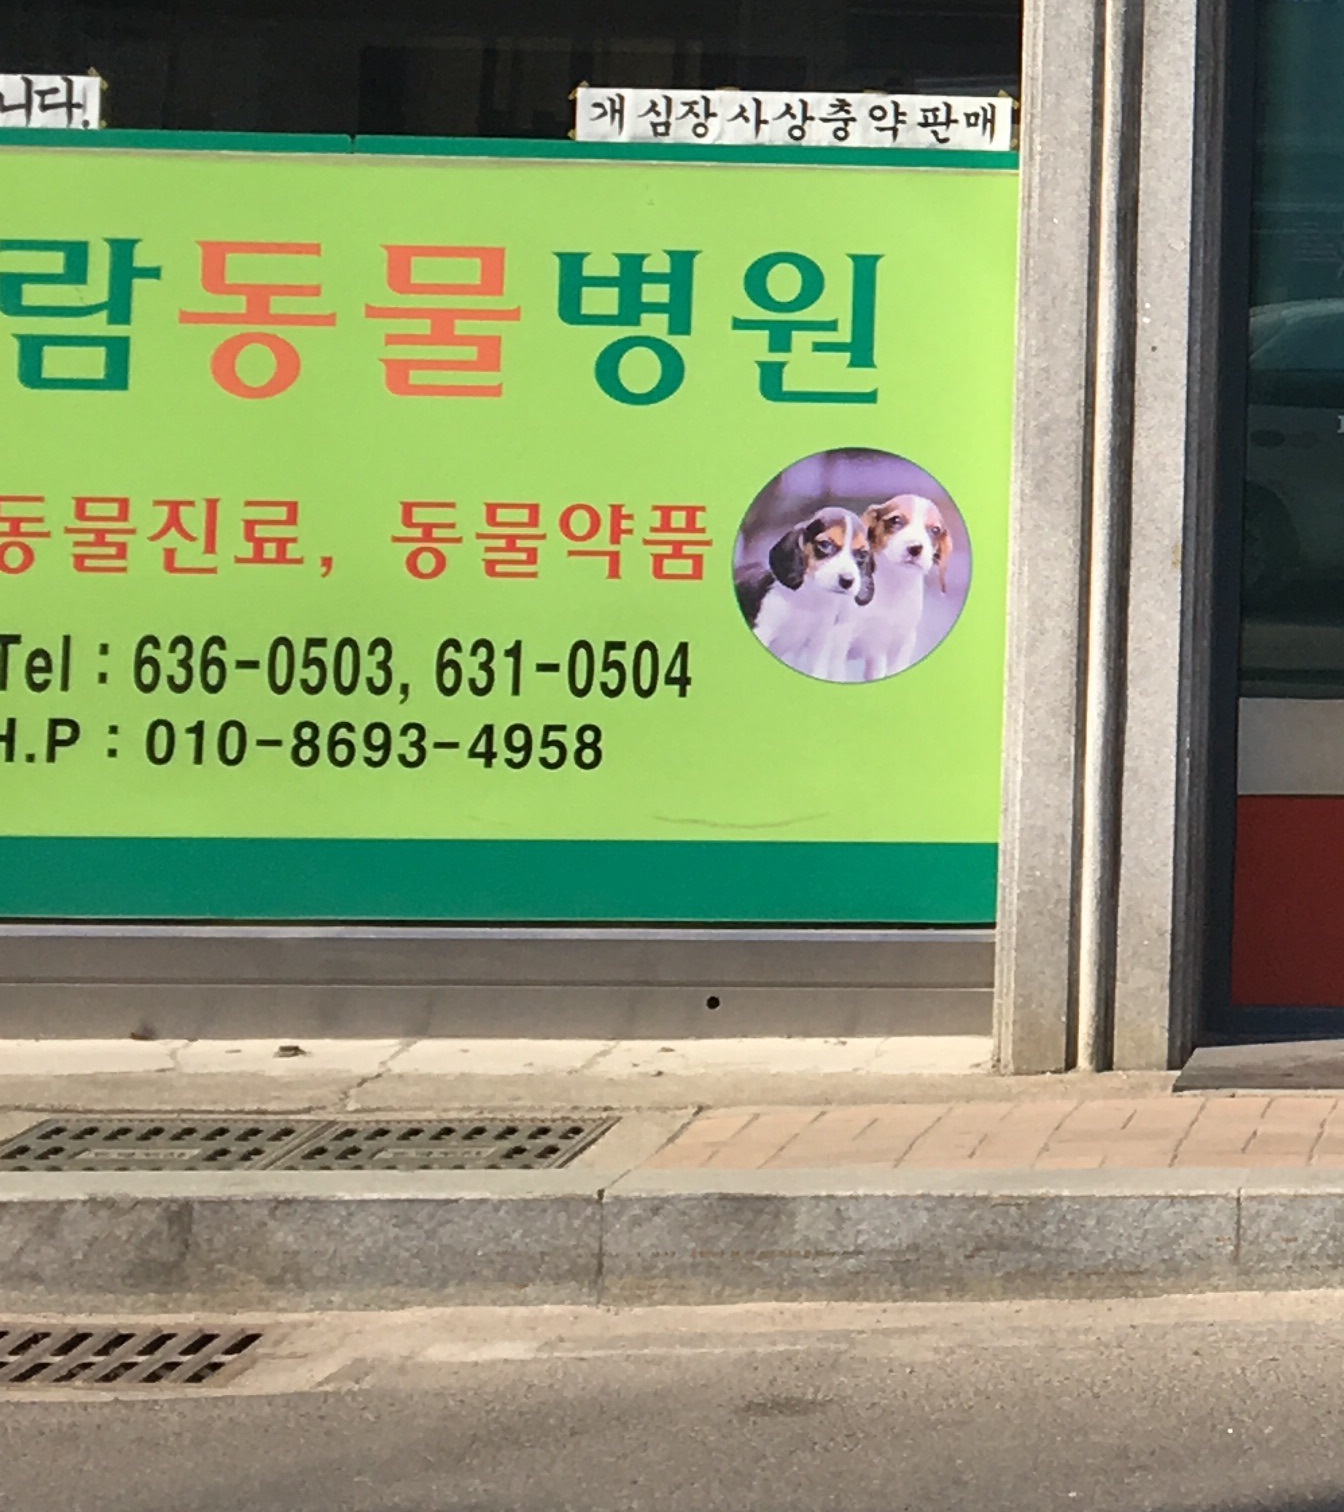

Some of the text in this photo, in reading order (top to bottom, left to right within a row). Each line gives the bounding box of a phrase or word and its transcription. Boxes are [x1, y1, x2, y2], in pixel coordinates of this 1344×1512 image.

[0, 237, 885, 405] 람동물병원
[0, 495, 714, 580] 동물진료, 동물약품
[0, 634, 72, 693] Tel
[133, 634, 410, 702] 636-0503,
[434, 639, 692, 699] 631-0504
[145, 718, 604, 770] 010-8693-4958
